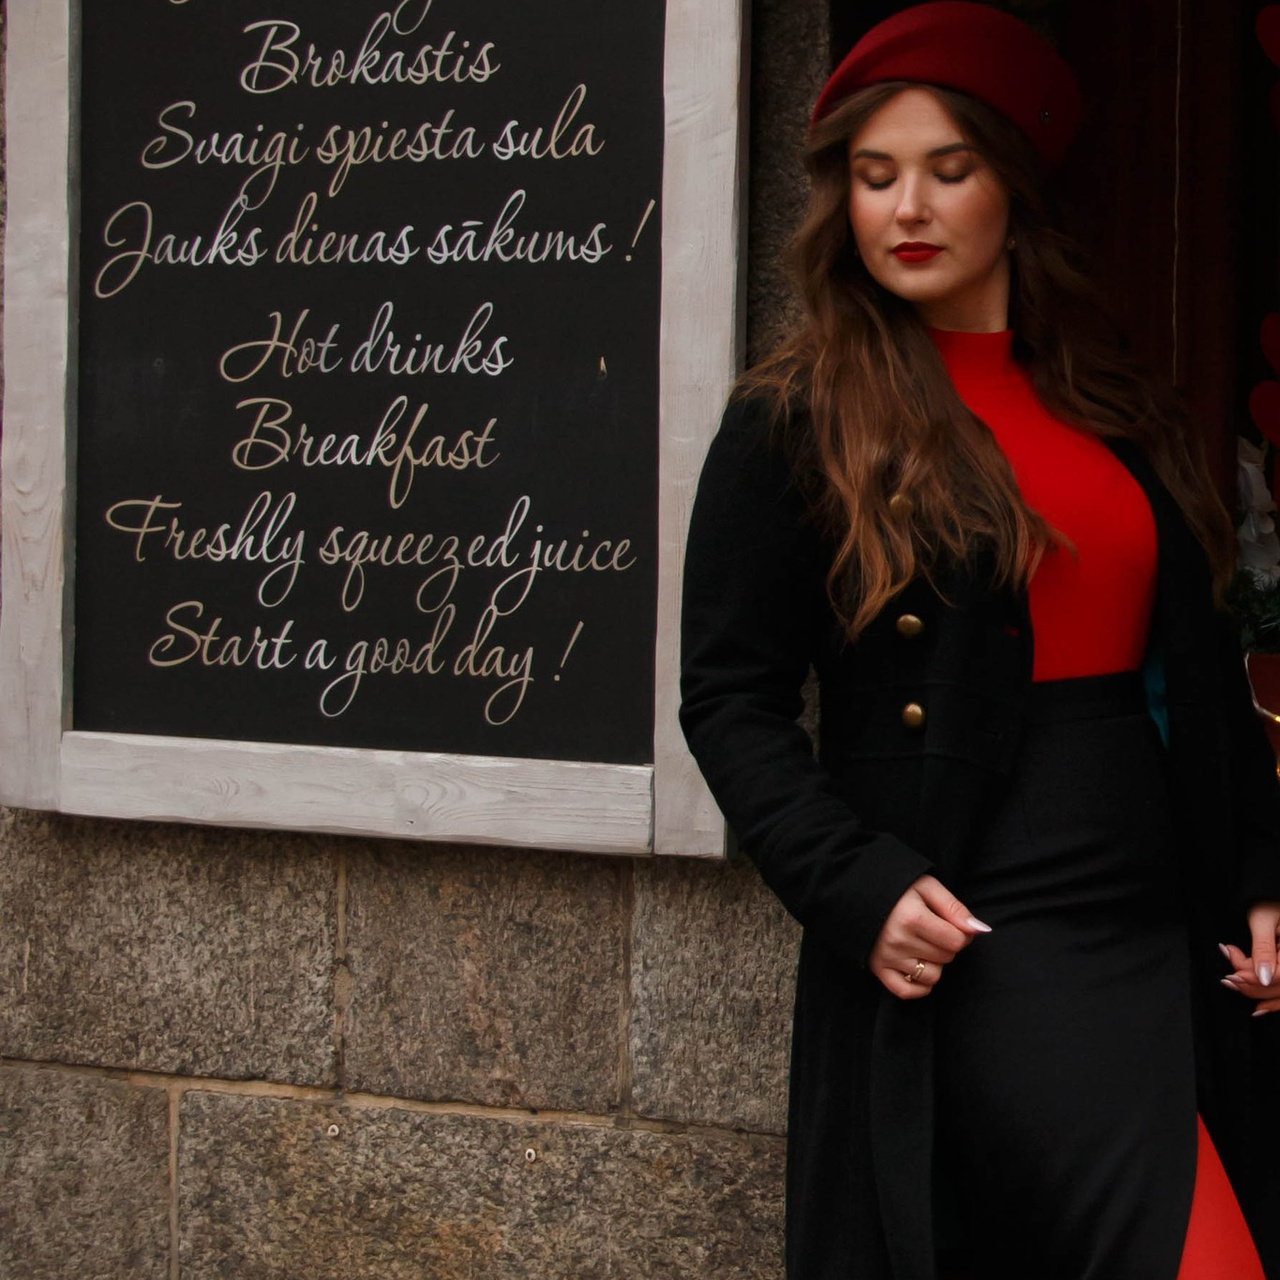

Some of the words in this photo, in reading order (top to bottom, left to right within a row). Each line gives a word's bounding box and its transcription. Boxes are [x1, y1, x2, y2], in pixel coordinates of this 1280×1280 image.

[240, 12, 501, 95] Brokastis
[141, 100, 309, 212] Svaigi
[316, 109, 485, 198] spiesta
[492, 84, 605, 163] sula
[95, 194, 267, 298] Jauks
[276, 191, 419, 266] dienas
[427, 189, 612, 266] sākums
[219, 308, 342, 383] Hot
[350, 301, 514, 377] drinks
[232, 395, 499, 510] Breakfast
[106, 491, 305, 608] Freshly
[319, 496, 529, 614] squeezed
[491, 524, 637, 615] juice
[148, 601, 296, 669] Start
[304, 632, 336, 670] a
[320, 604, 456, 718] good
[454, 604, 534, 726] day
